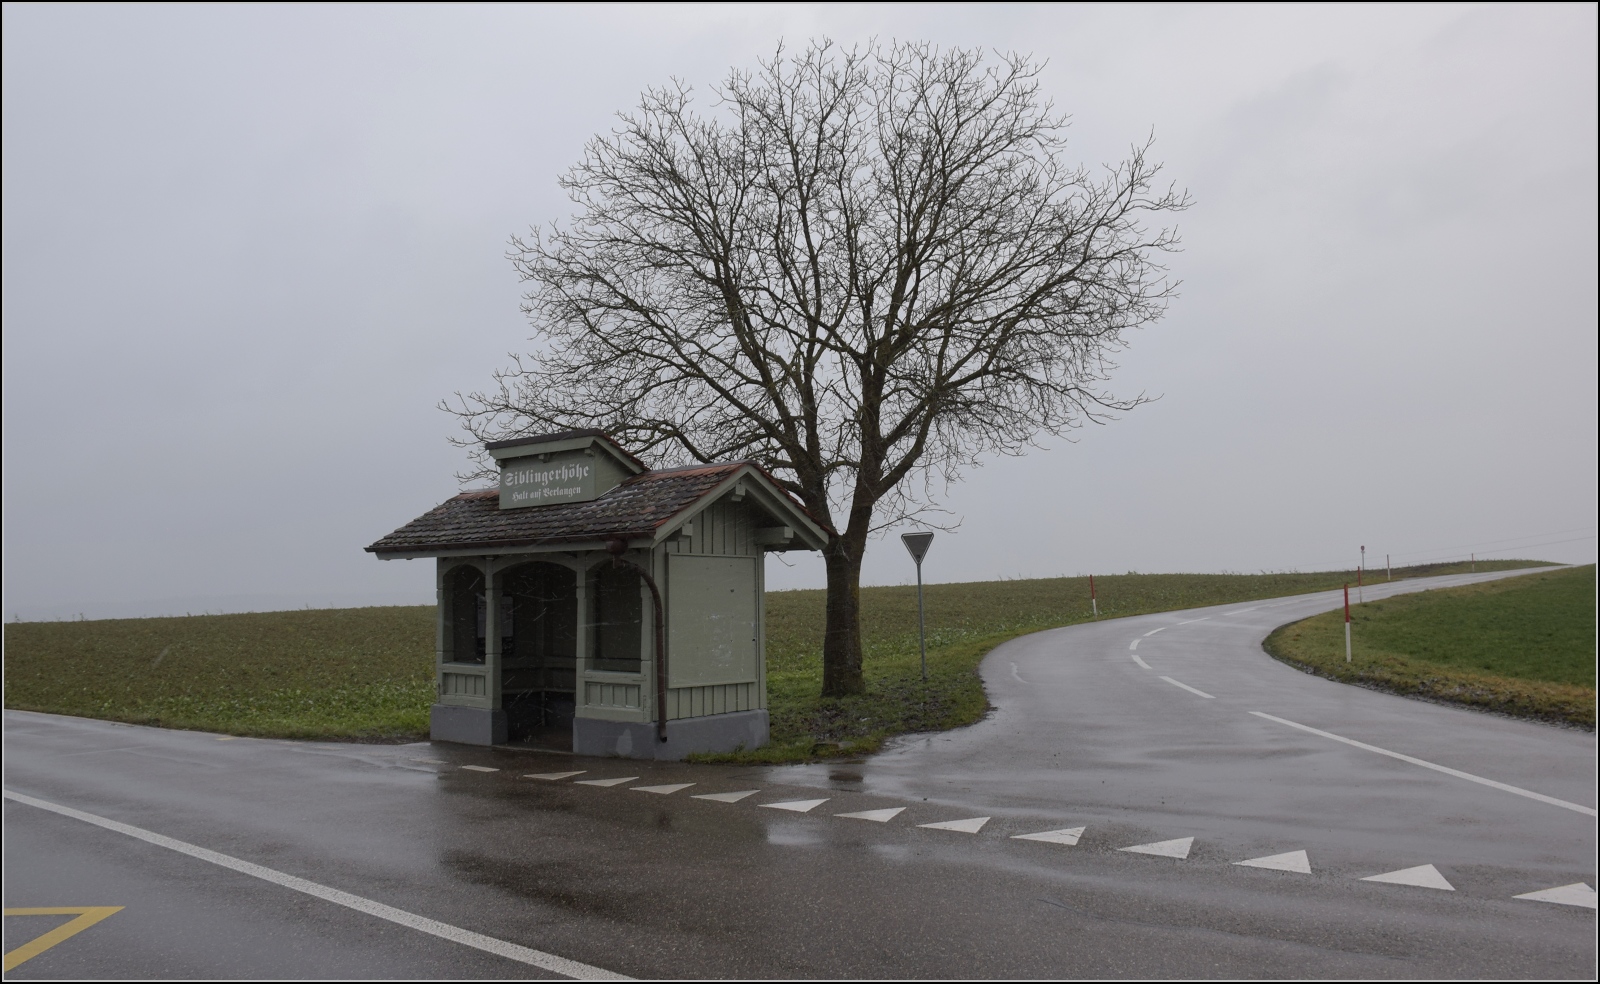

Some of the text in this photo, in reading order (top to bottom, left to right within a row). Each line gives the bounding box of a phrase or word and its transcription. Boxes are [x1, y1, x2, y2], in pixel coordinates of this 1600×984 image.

[504, 463, 589, 486] Siblingerhöhe
[512, 486, 581, 503] Halt auf Verlangen
